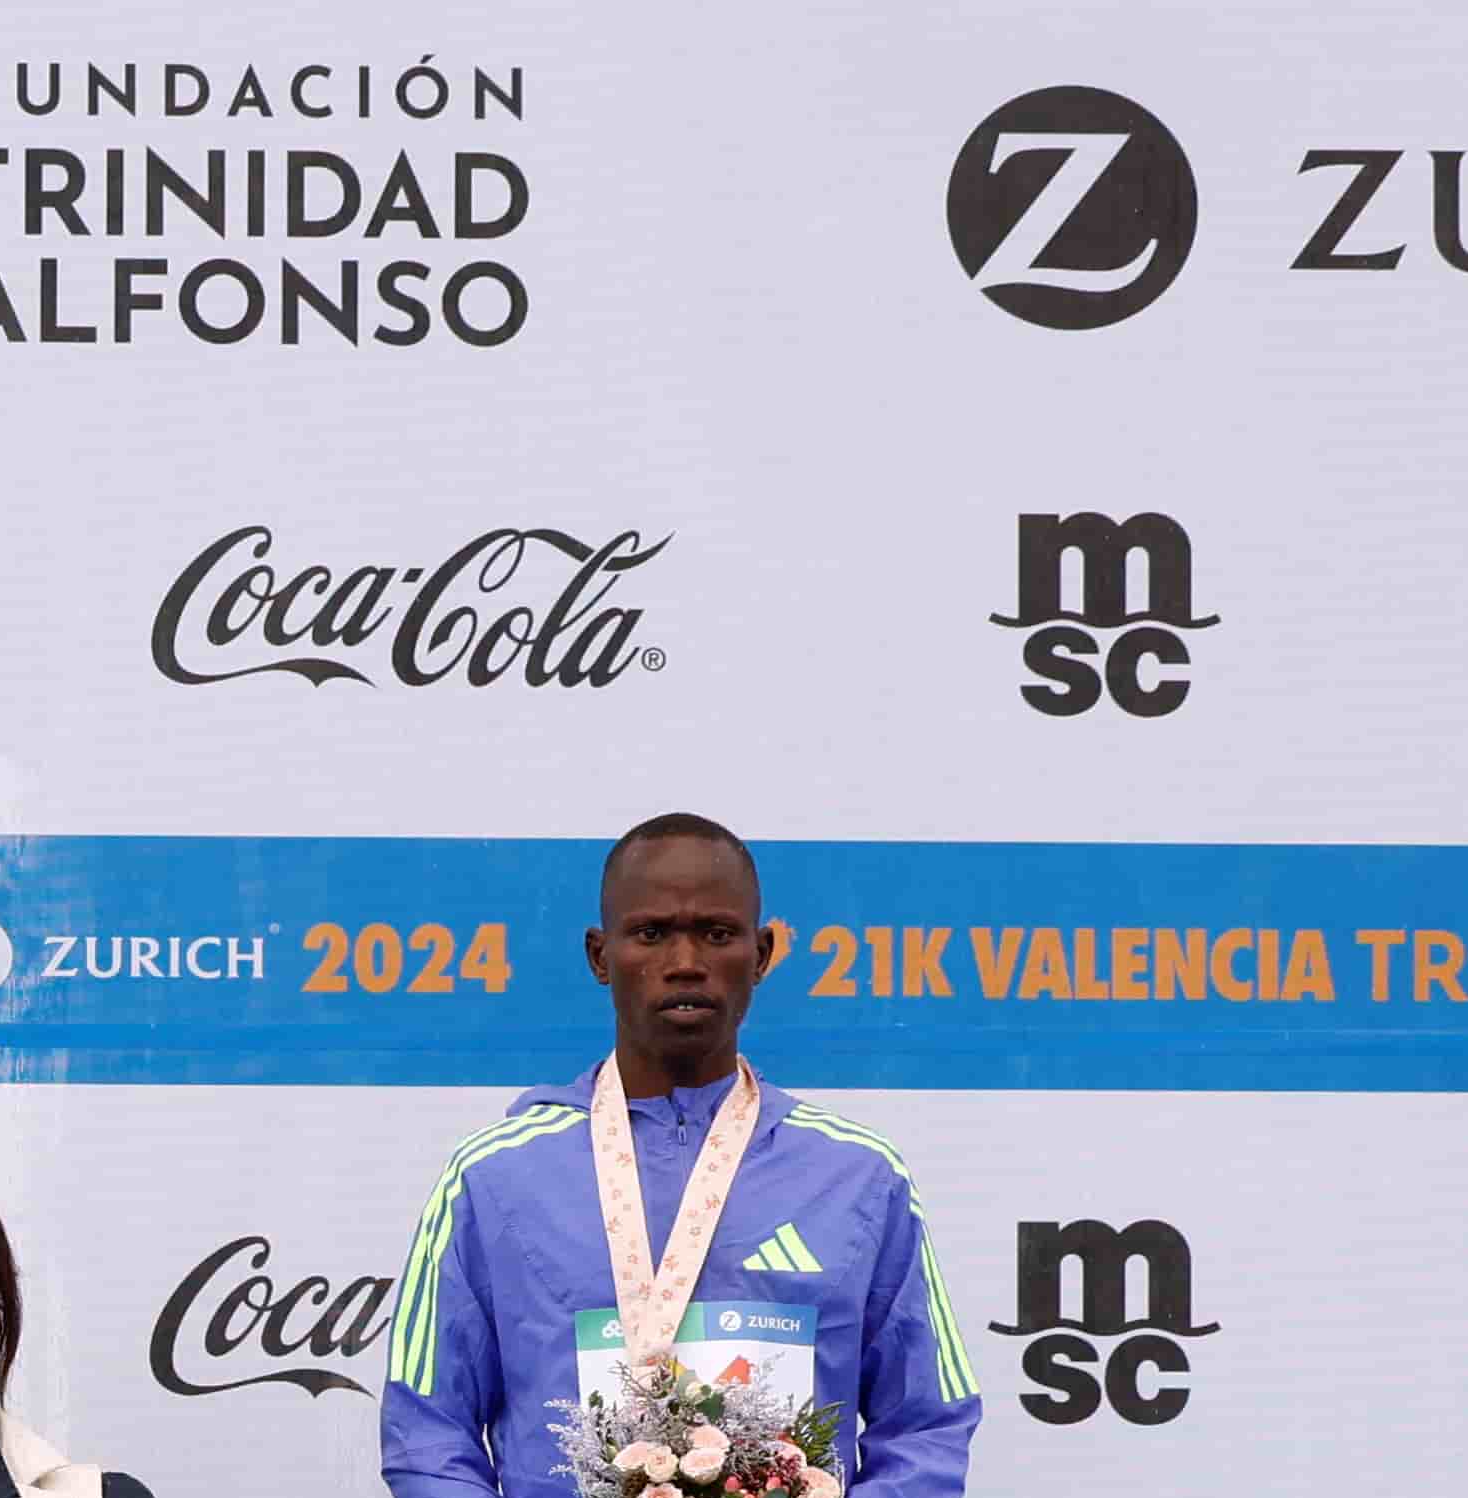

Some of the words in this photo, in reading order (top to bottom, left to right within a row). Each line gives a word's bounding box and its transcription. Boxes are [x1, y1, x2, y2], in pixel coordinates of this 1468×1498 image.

[151, 526, 672, 688] Coca-Cola
[40, 936, 263, 978] ZURICH
[303, 923, 512, 993] 2024
[810, 925, 952, 997] 21K
[970, 928, 1335, 1002] VALENCIA
[748, 1314, 801, 1331] ZURICH
